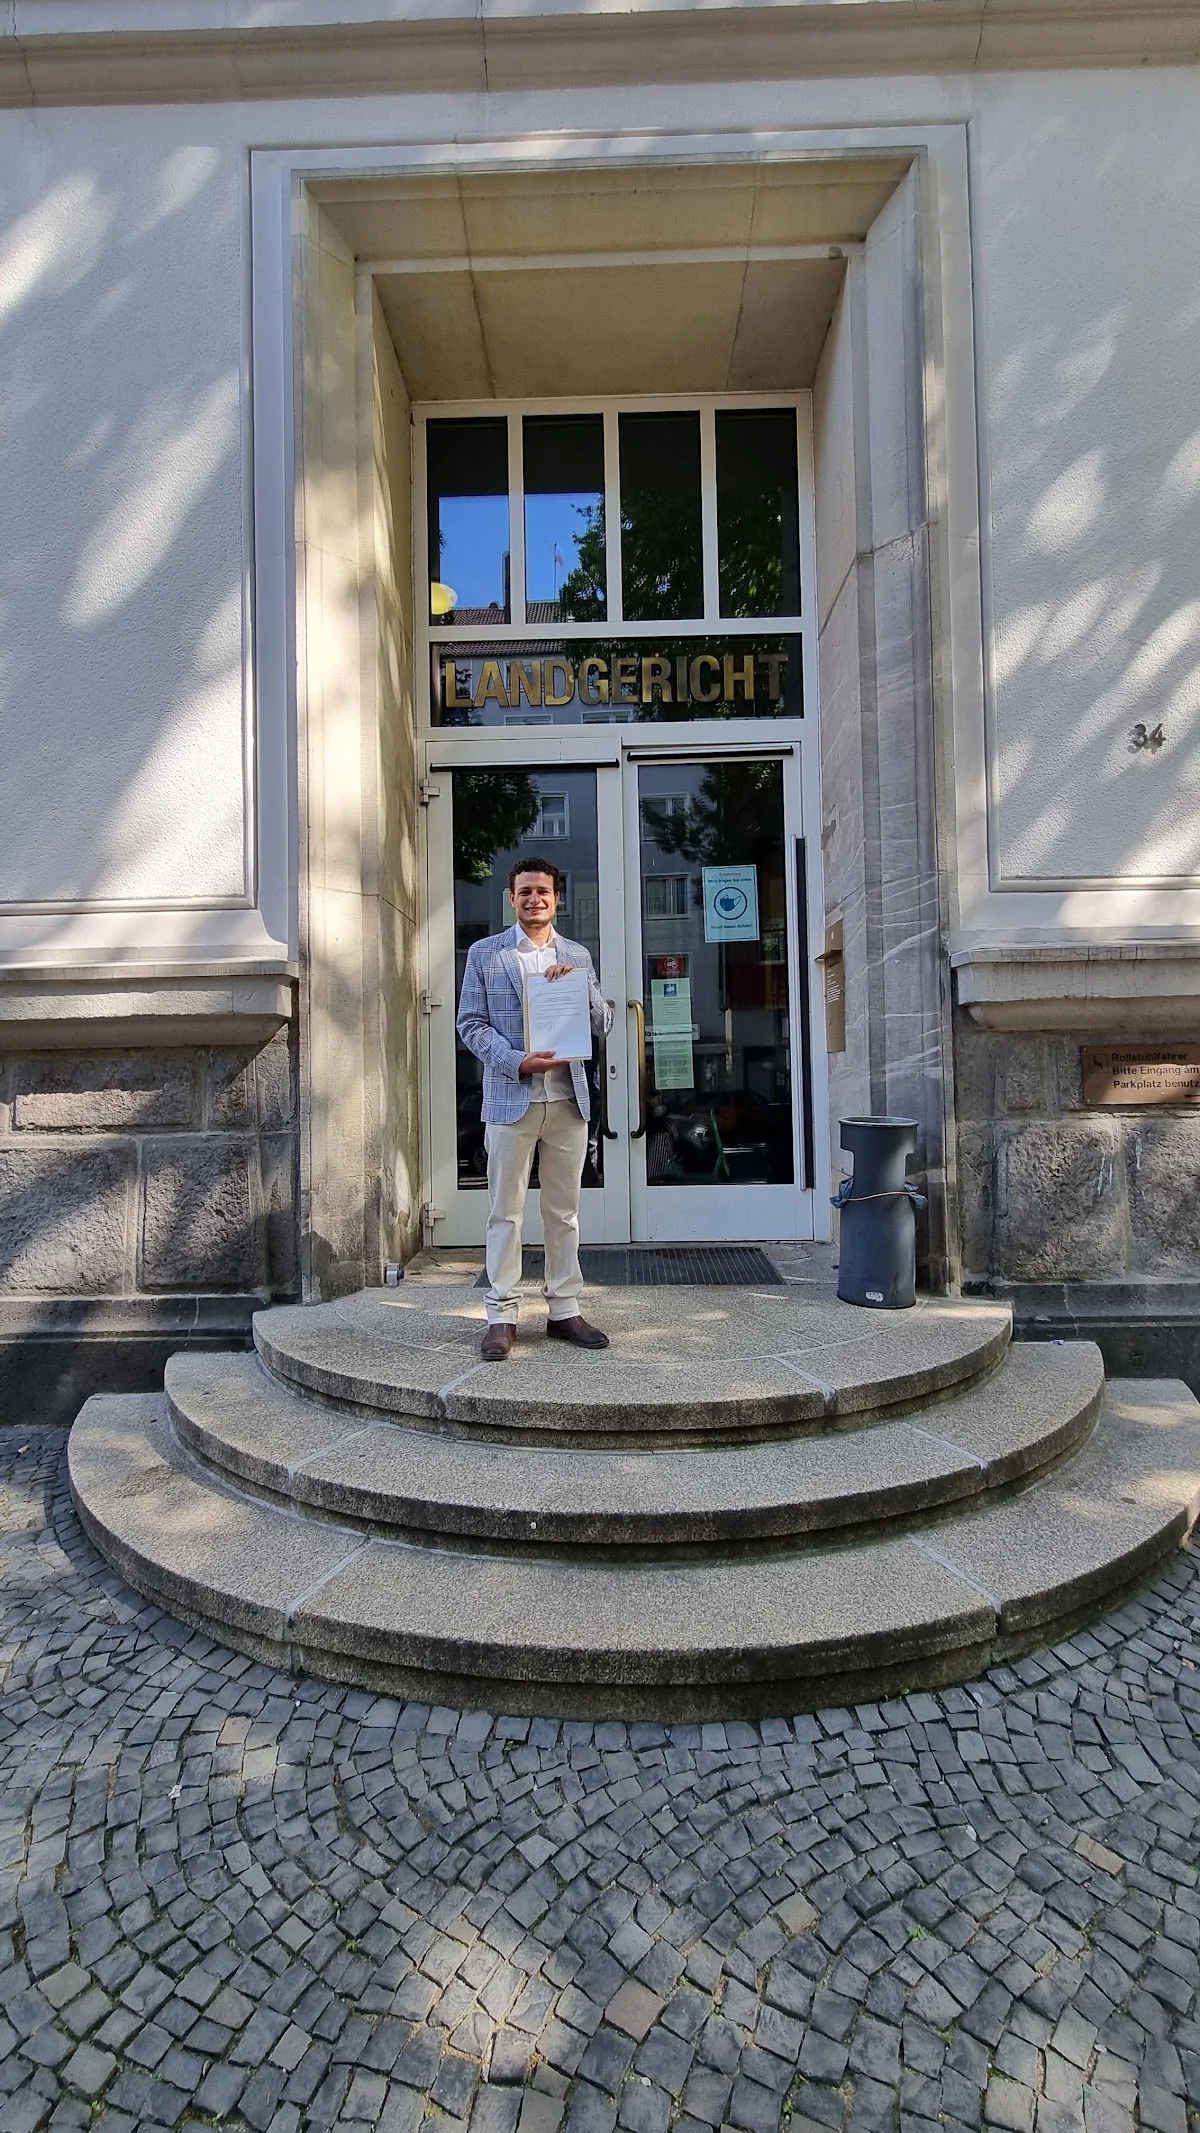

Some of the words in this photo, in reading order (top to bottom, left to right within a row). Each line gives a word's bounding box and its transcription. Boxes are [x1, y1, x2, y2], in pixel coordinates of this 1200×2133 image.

[445, 654, 789, 708] LANDGERICHT
[1133, 723, 1167, 747] 34
[1111, 1053, 1188, 1062] Rollstuhlfahrer
[1112, 1066, 1137, 1075] Bitte
[1140, 1066, 1181, 1076] Eingang
[1113, 1080, 1162, 1090] Parkplatz
